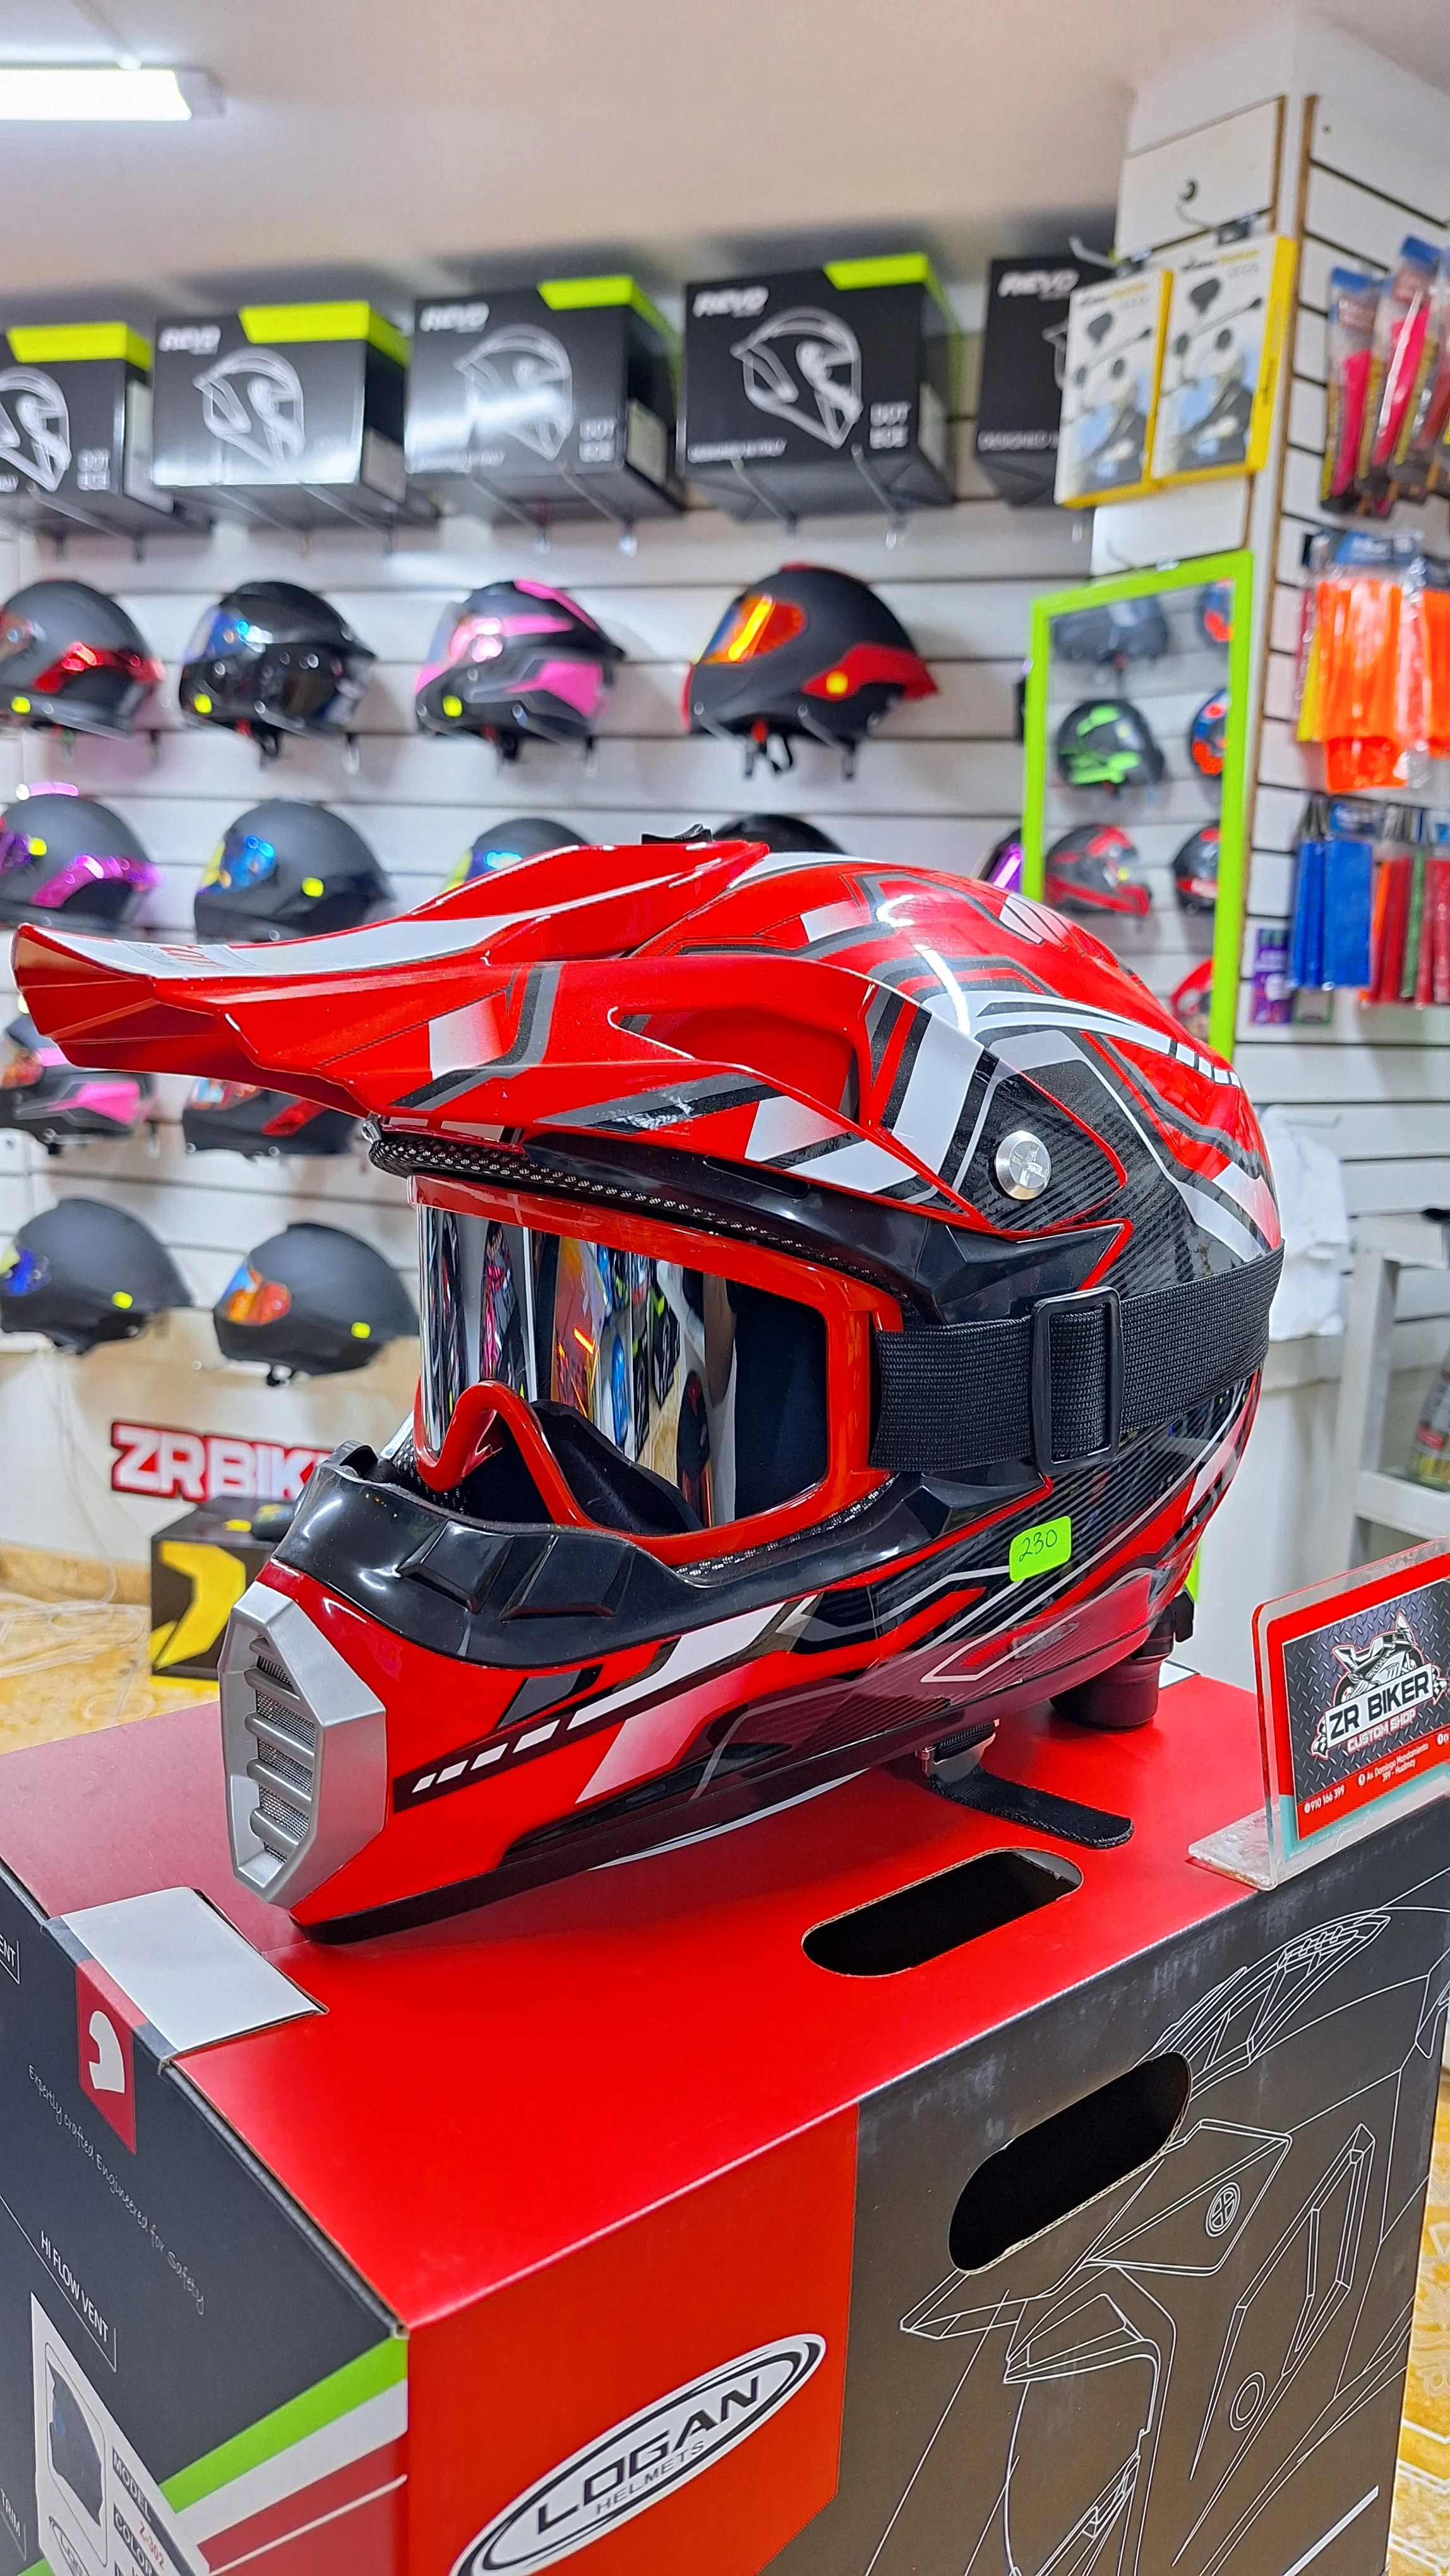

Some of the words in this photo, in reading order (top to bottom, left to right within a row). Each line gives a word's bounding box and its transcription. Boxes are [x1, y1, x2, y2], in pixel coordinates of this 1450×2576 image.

[1019, 1529, 1057, 1563] 230
[1329, 1703, 1360, 1741] ZR
[1367, 1671, 1430, 1722] BIKER
[1347, 1723, 1389, 1753] CUSTOM
[1390, 1708, 1417, 1731] SHOP
[1310, 1798, 1322, 1811] 910
[1322, 1791, 1333, 1805] 166
[1333, 1785, 1345, 1799] 399
[1374, 1760, 1396, 1777] Domingo
[29, 2065, 62, 2125] Expertly
[64, 2114, 94, 2160] crafted
[96, 2154, 148, 2233] Engineered
[150, 2224, 165, 2253] for
[167, 2251, 204, 2315] Safety
[41, 2230, 51, 2259] HI
[53, 2248, 80, 2300] FLOW
[81, 2289, 109, 2342] VENT
[114, 2452, 153, 2523] MODEL
[537, 2375, 759, 2534] LOGAN
[596, 2440, 705, 2515] HELMETS
[115, 2512, 153, 2576] COLOR
[139, 2519, 165, 2571] Z-302
